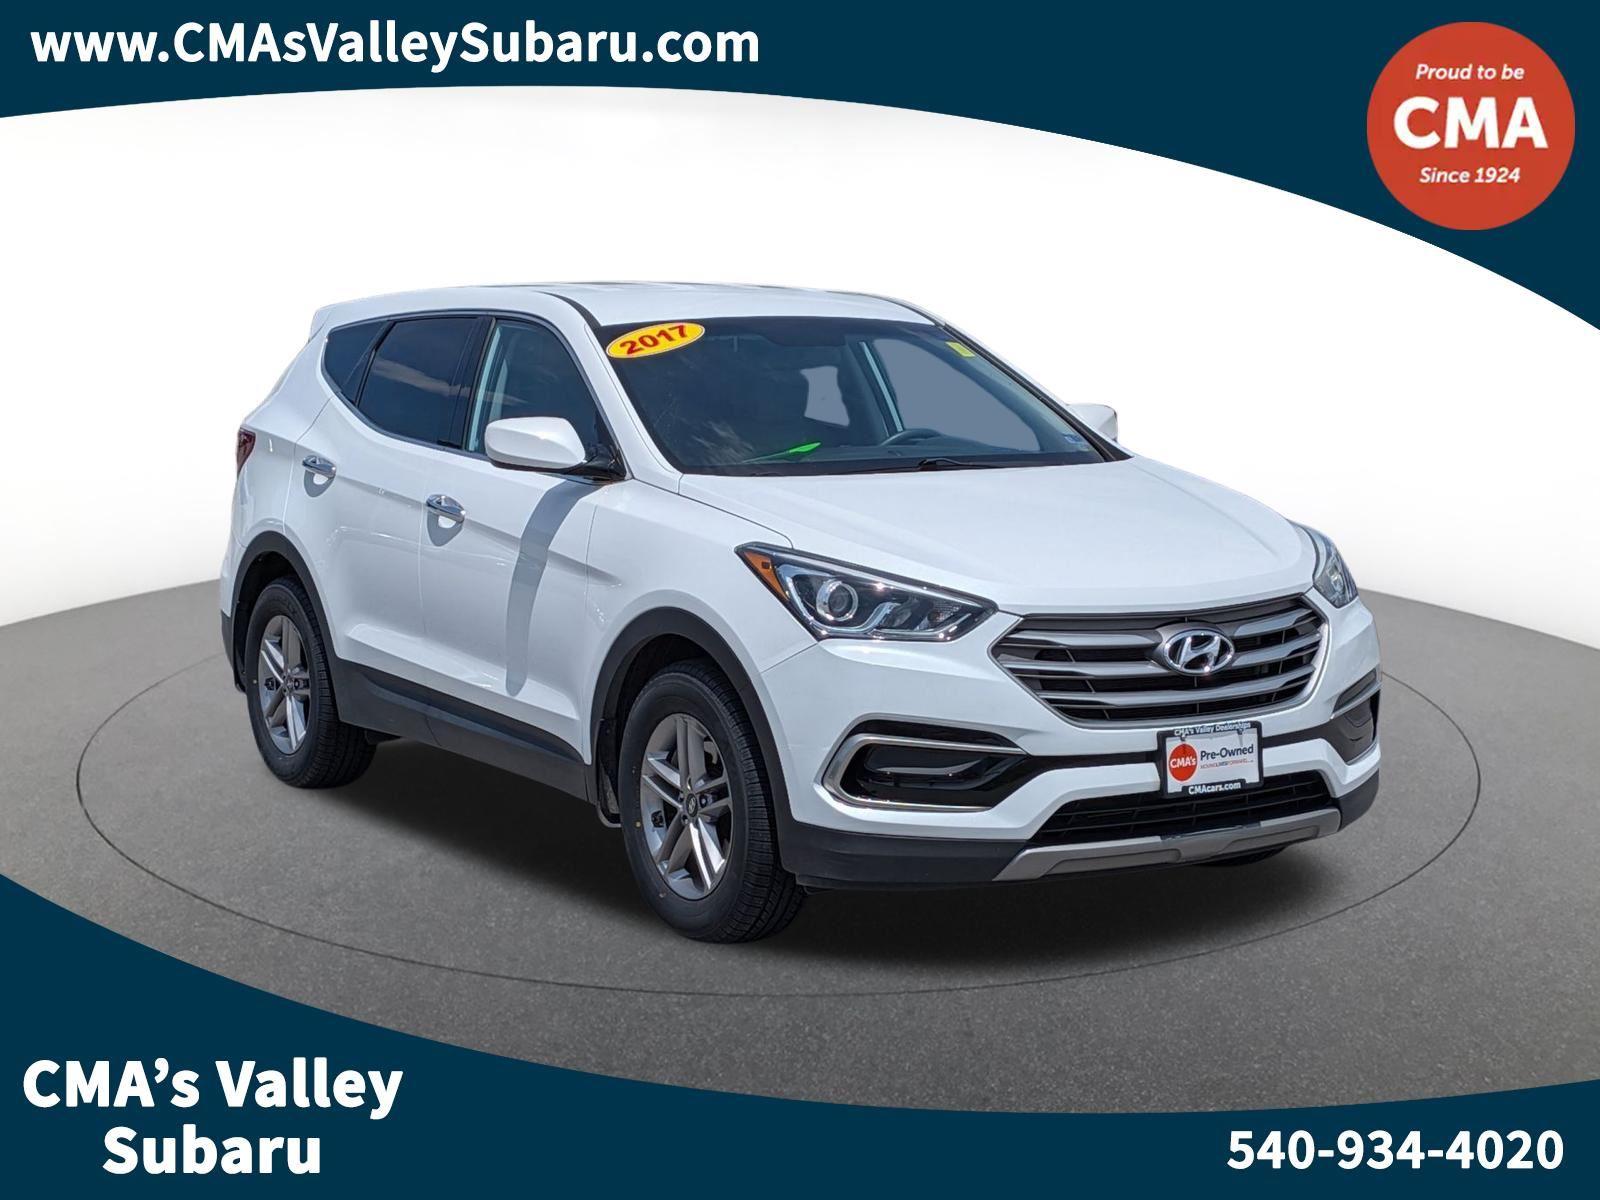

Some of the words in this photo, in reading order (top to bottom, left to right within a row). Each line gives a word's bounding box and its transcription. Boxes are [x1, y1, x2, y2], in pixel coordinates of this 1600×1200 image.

[620, 325, 688, 355] 2017
[1196, 725, 1214, 734] Valley
[1200, 744, 1254, 761] Pre-Owned
[1170, 757, 1196, 769] CMA's
[1188, 781, 1241, 795] CMAcars.com
